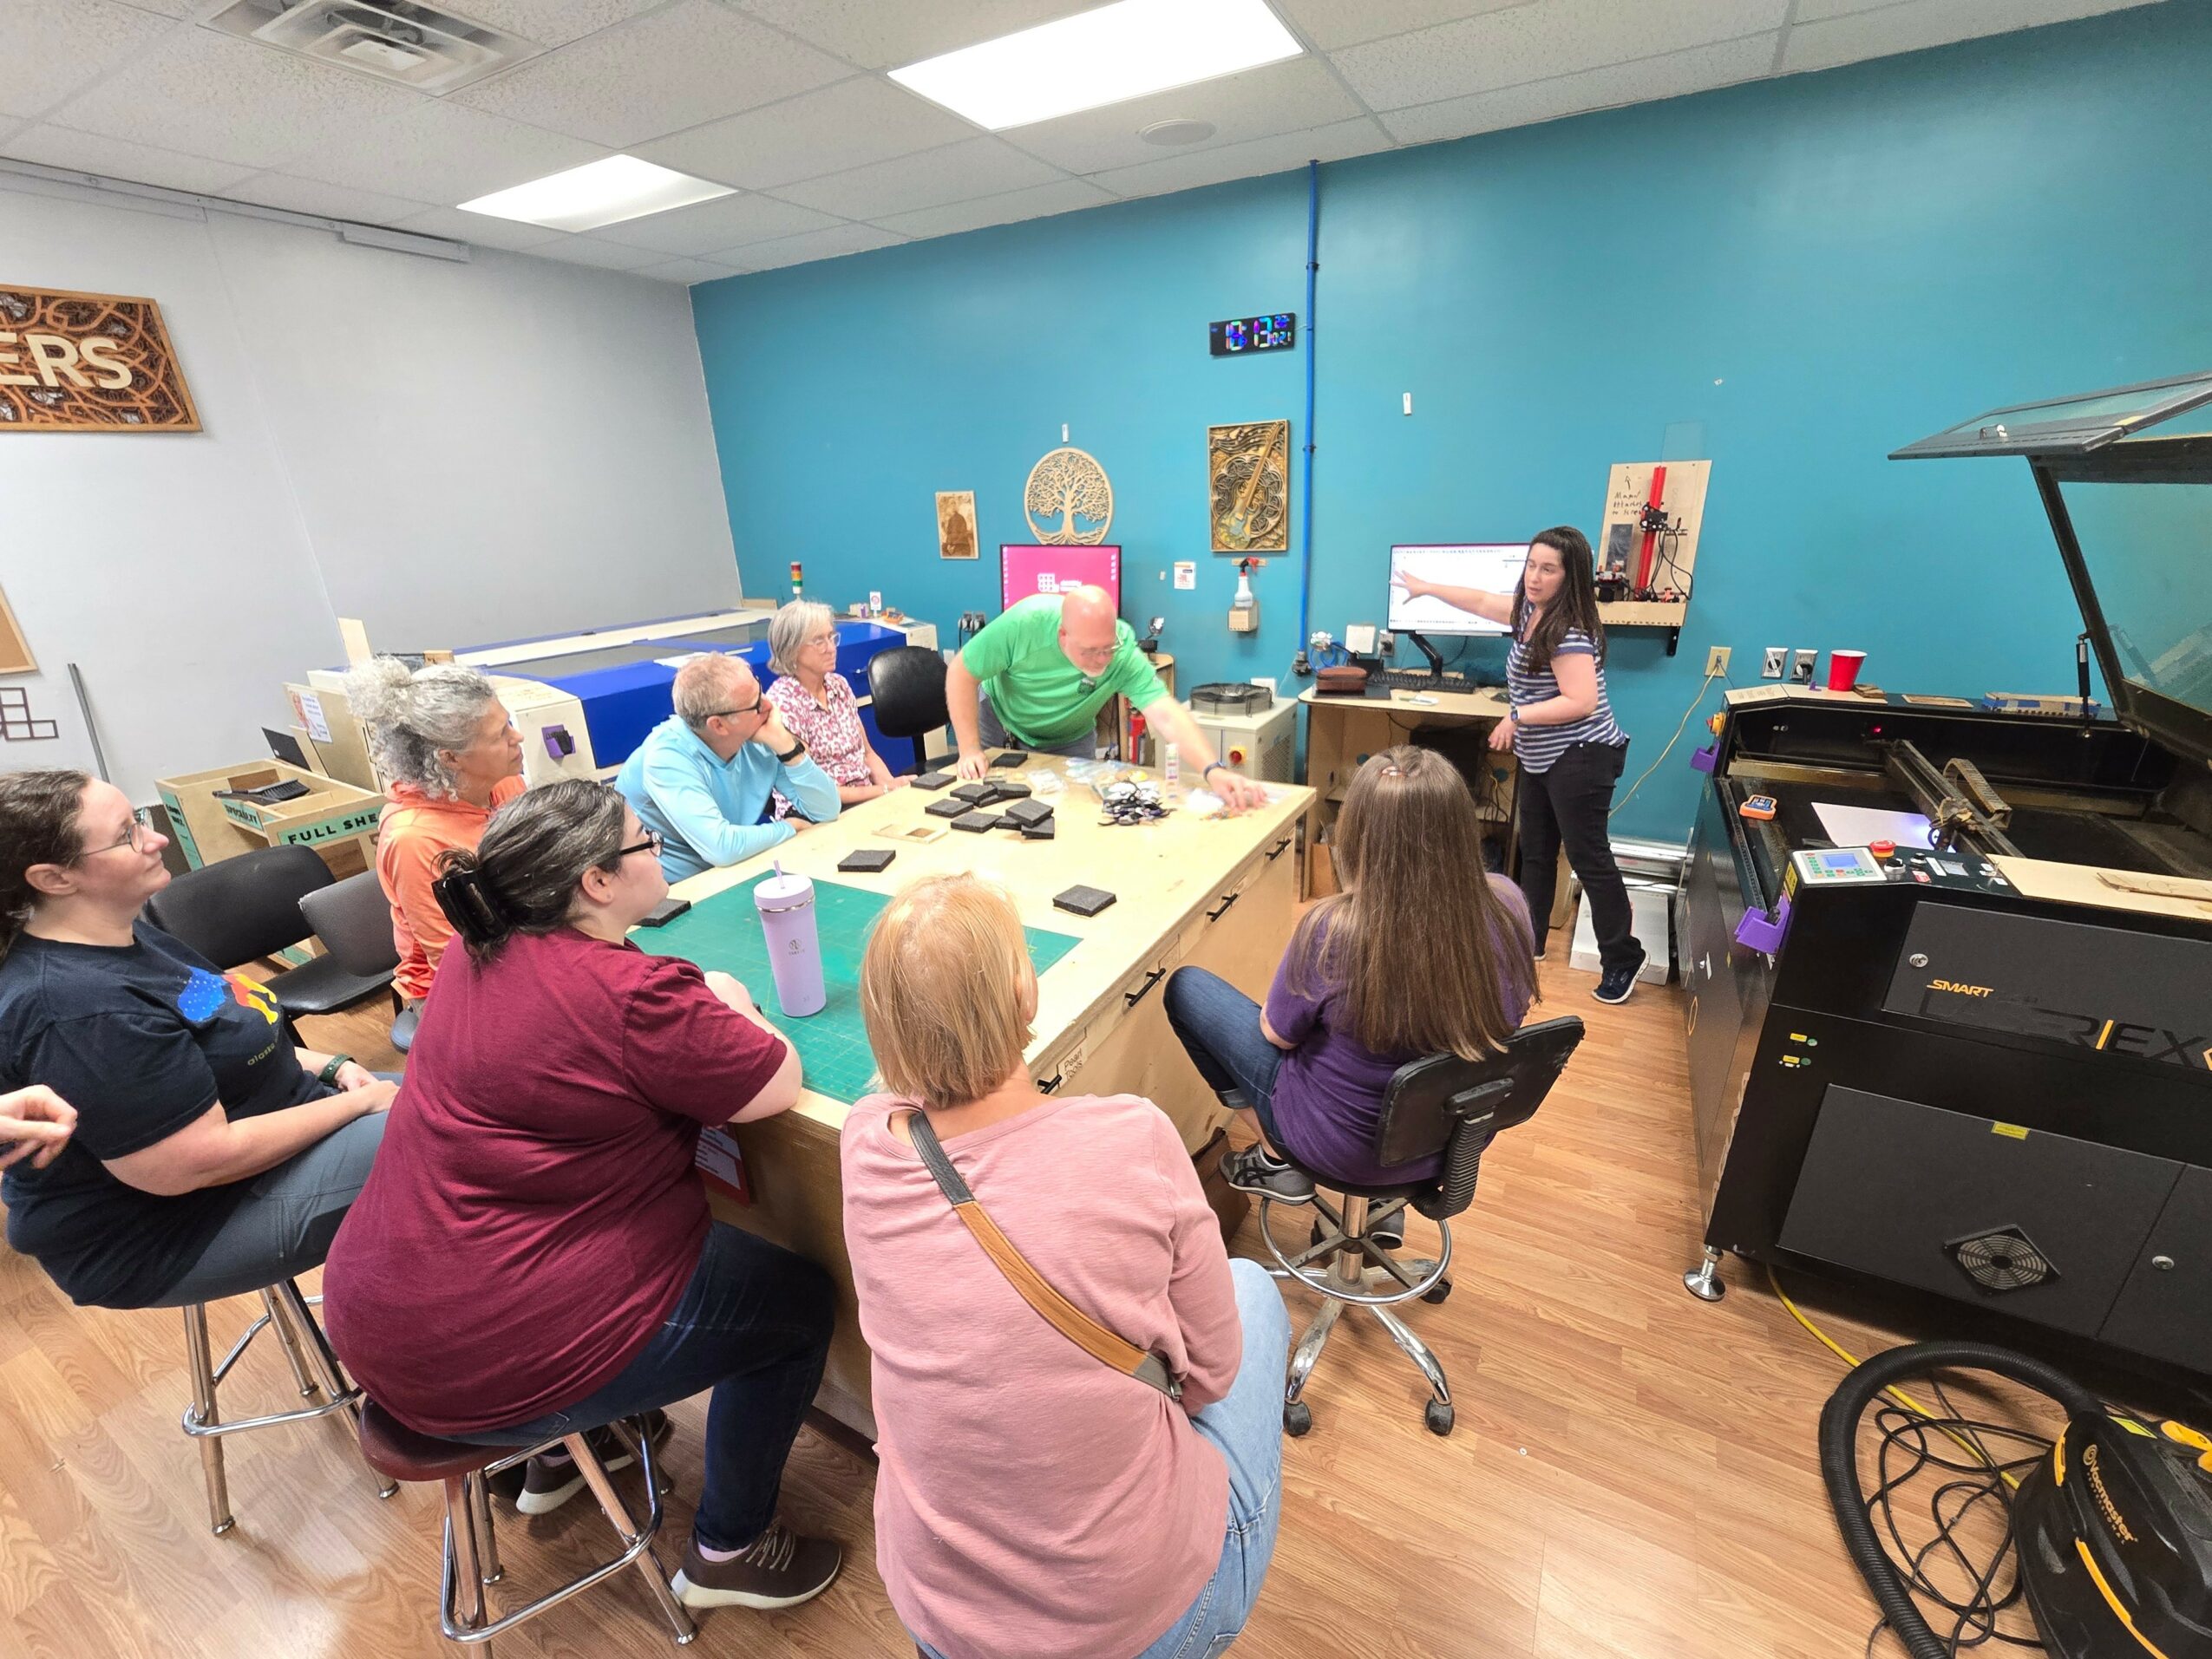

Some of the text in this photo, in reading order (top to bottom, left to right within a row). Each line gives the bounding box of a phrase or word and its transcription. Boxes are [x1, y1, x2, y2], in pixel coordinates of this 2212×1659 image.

[288, 826, 337, 846] FULL
[1927, 979, 1994, 997] SMART
[2090, 1460, 2135, 1541] Vacmaster
